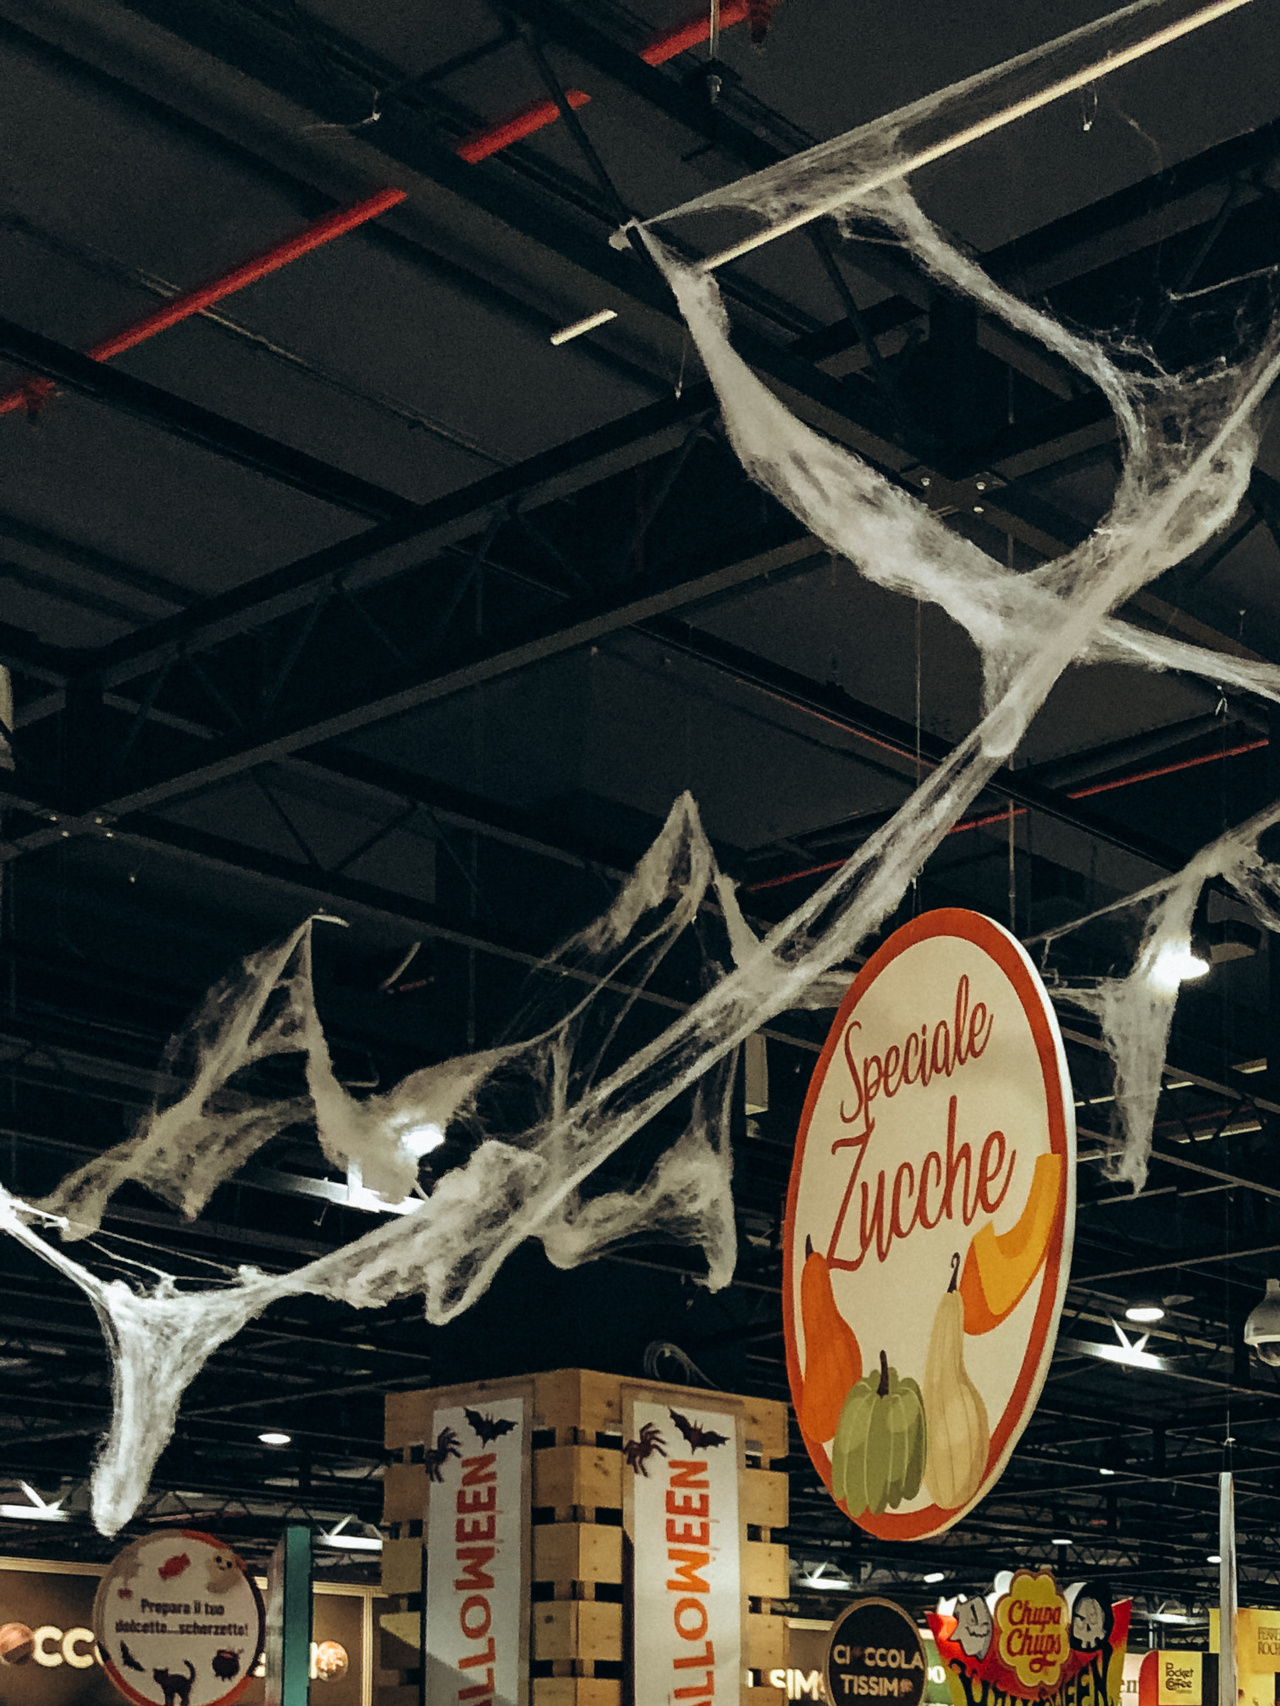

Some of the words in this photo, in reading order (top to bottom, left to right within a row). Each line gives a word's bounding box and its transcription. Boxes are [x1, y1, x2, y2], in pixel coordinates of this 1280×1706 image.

[840, 974, 994, 1125] Speciale
[827, 1094, 1016, 1271] Zucche
[141, 1598, 190, 1616] Prepara
[194, 1599, 203, 1614] il
[204, 1600, 225, 1615] tuo
[1008, 1600, 1061, 1632] Chupa
[1007, 1628, 1061, 1668] Chups
[1165, 1662, 1195, 1678] Pocket
[1165, 1678, 1193, 1691] Coffee
